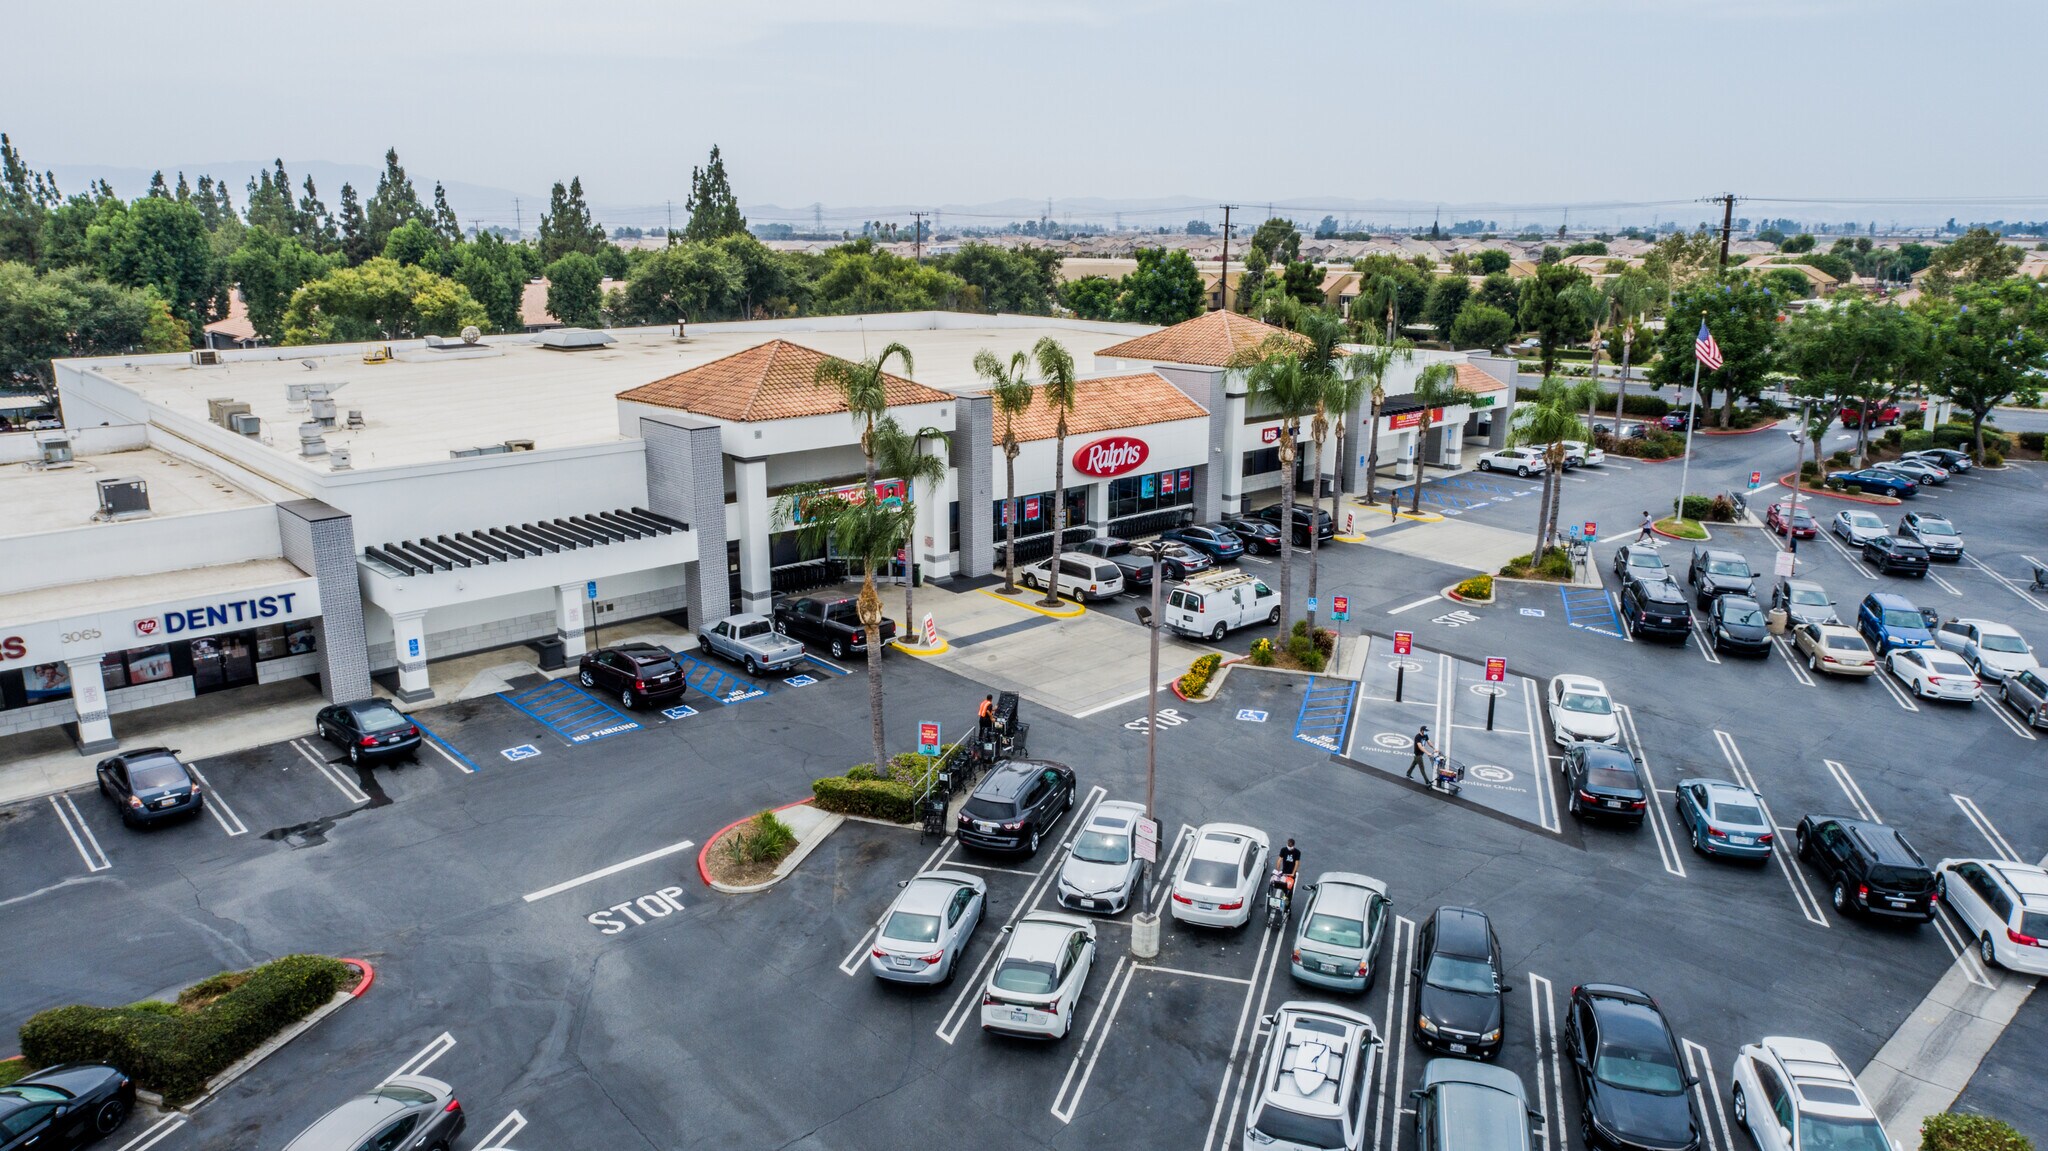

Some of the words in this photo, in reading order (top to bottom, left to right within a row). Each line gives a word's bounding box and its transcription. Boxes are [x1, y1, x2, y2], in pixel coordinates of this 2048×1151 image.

[1087, 441, 1141, 473] Ralphs
[164, 592, 297, 634] DENTIST
[1431, 610, 1480, 627] STOP
[60, 629, 102, 644] 3065
[722, 690, 764, 703] PARKING
[729, 689, 745, 697] NO
[572, 734, 590, 742] NO
[592, 722, 639, 737] PARKING
[1296, 733, 1339, 751] PARKING
[1361, 745, 1391, 754] Online
[1459, 779, 1492, 788] Online
[1493, 784, 1527, 793] Orders
[588, 886, 685, 934] STOP
